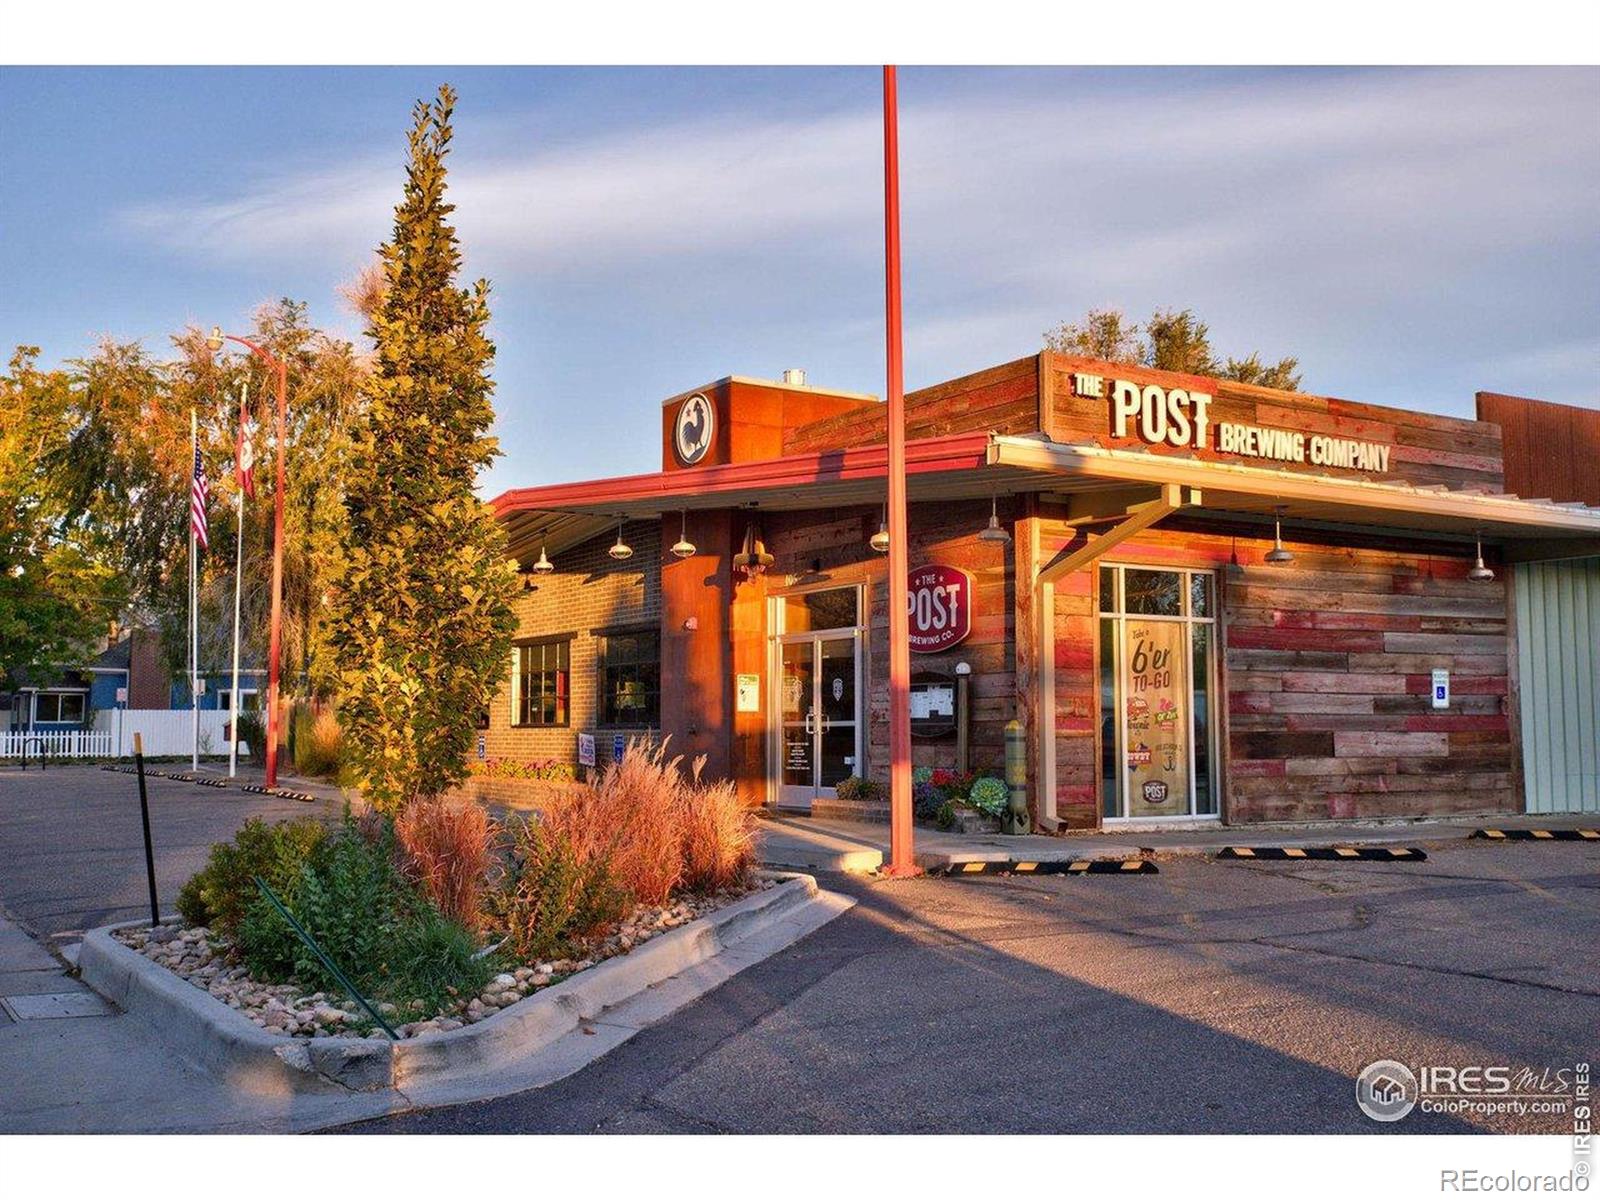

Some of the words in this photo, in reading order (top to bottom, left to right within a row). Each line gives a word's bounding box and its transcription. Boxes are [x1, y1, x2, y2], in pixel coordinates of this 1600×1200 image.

[1074, 373, 1104, 397] THE
[1111, 379, 1213, 448] POST
[1219, 422, 1305, 462] BREWING
[1310, 435, 1391, 473] COMPANY
[921, 573, 936, 585] THE
[1133, 670, 1170, 693] TO-GO
[1145, 785, 1166, 799] POST
